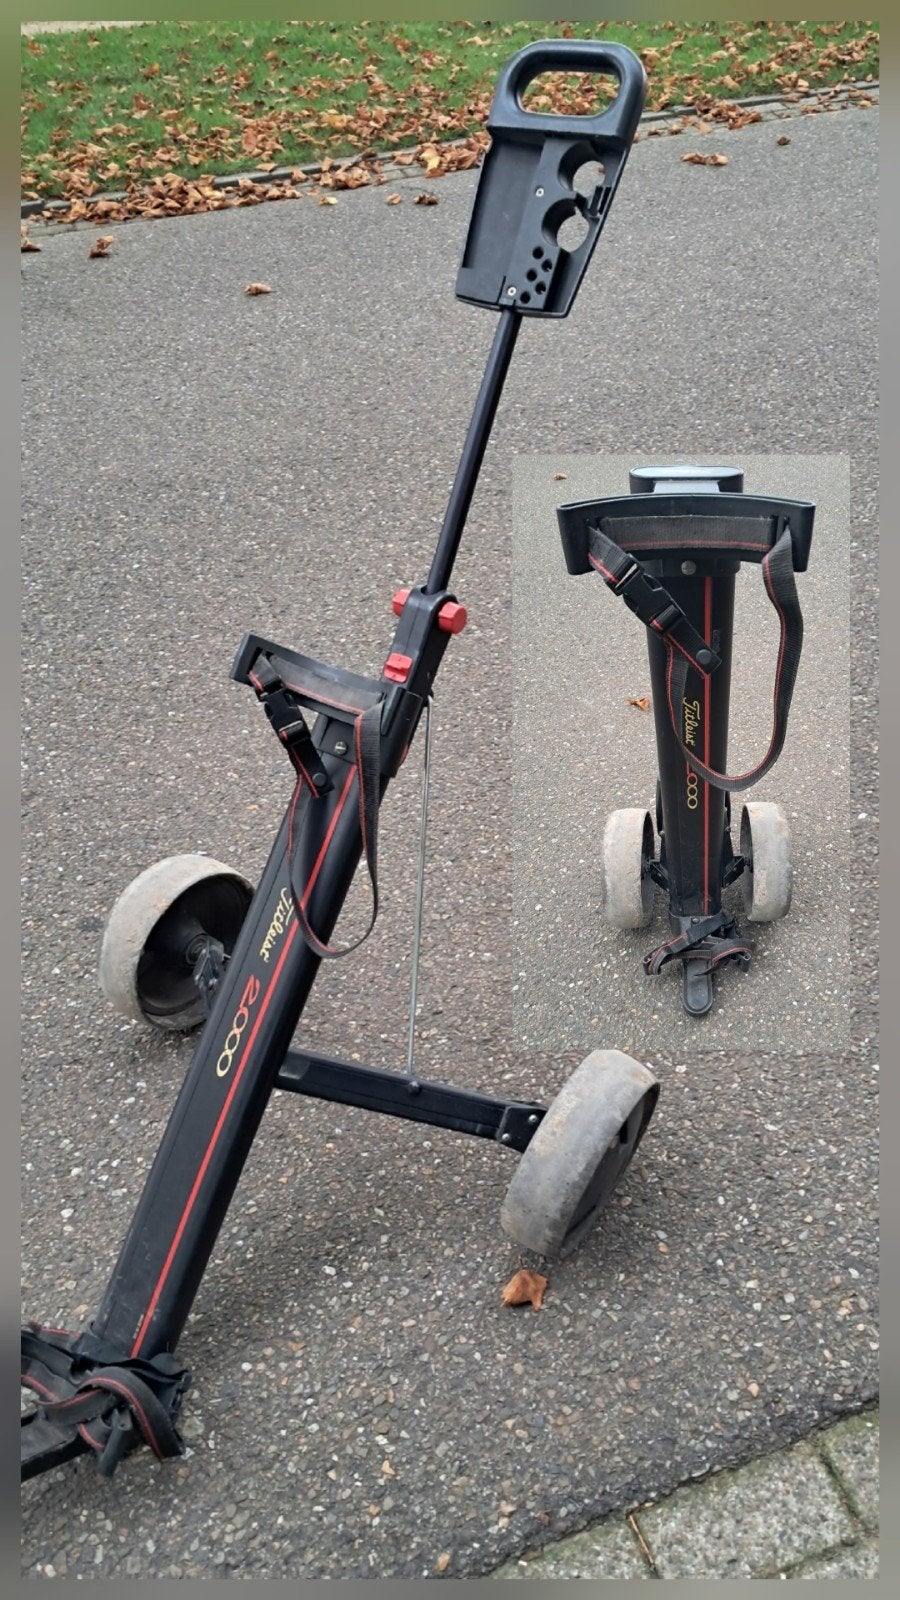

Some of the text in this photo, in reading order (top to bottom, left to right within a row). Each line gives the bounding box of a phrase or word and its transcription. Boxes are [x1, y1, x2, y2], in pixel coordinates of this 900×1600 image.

[682, 696, 700, 746] Titleist
[216, 886, 295, 1077] Titleist 2000
